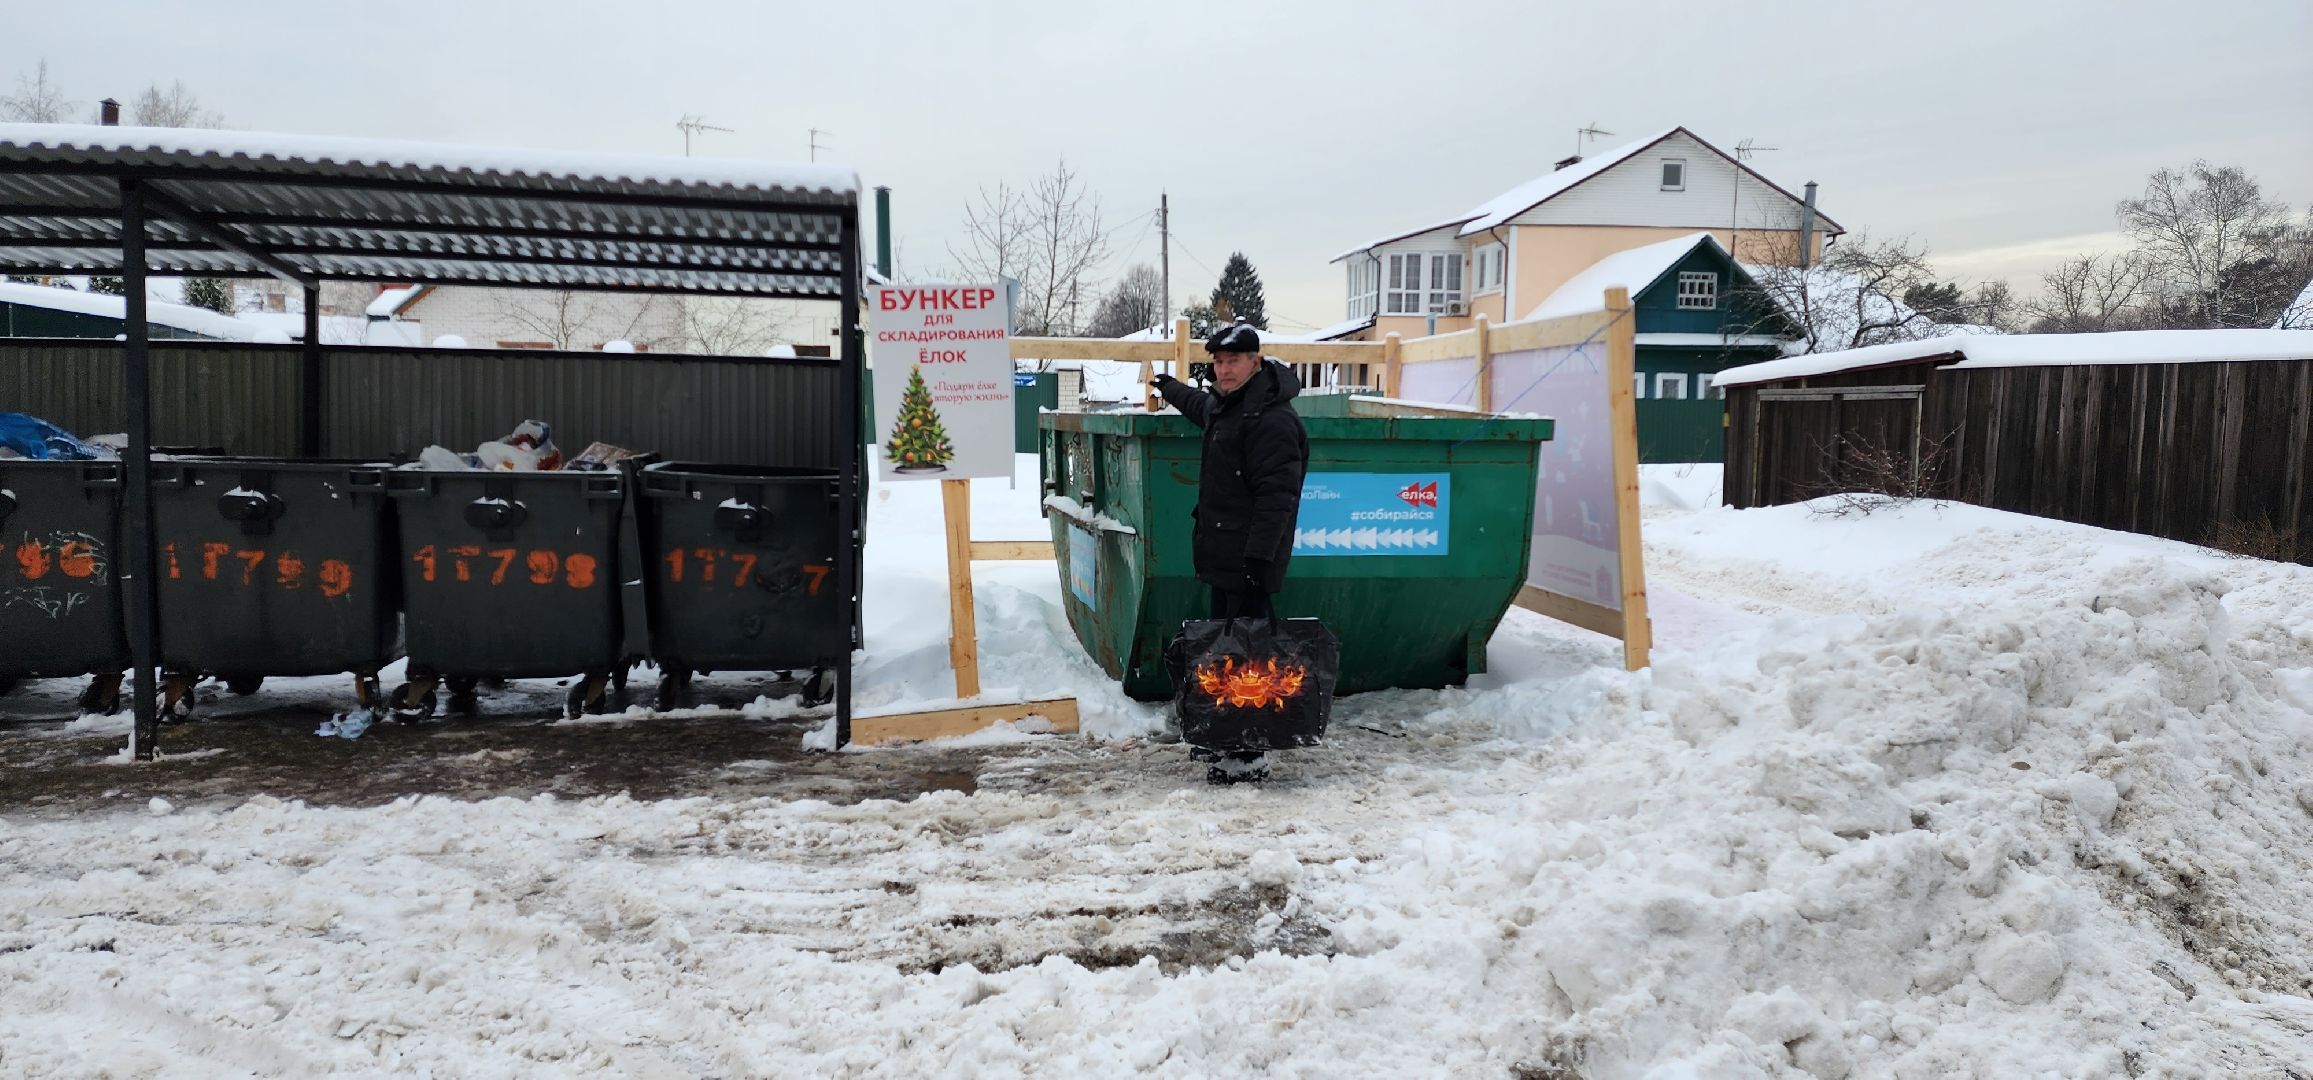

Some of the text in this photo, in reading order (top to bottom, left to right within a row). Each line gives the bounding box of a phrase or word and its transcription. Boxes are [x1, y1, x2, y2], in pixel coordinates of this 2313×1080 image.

[879, 288, 995, 311] БУНКЕР
[924, 314, 953, 327] ДЛЯ
[878, 329, 1004, 343] СКЛАДИРОВАНИЯ
[919, 348, 967, 364] ЁЛОК
[1351, 508, 1434, 522] #собирайся
